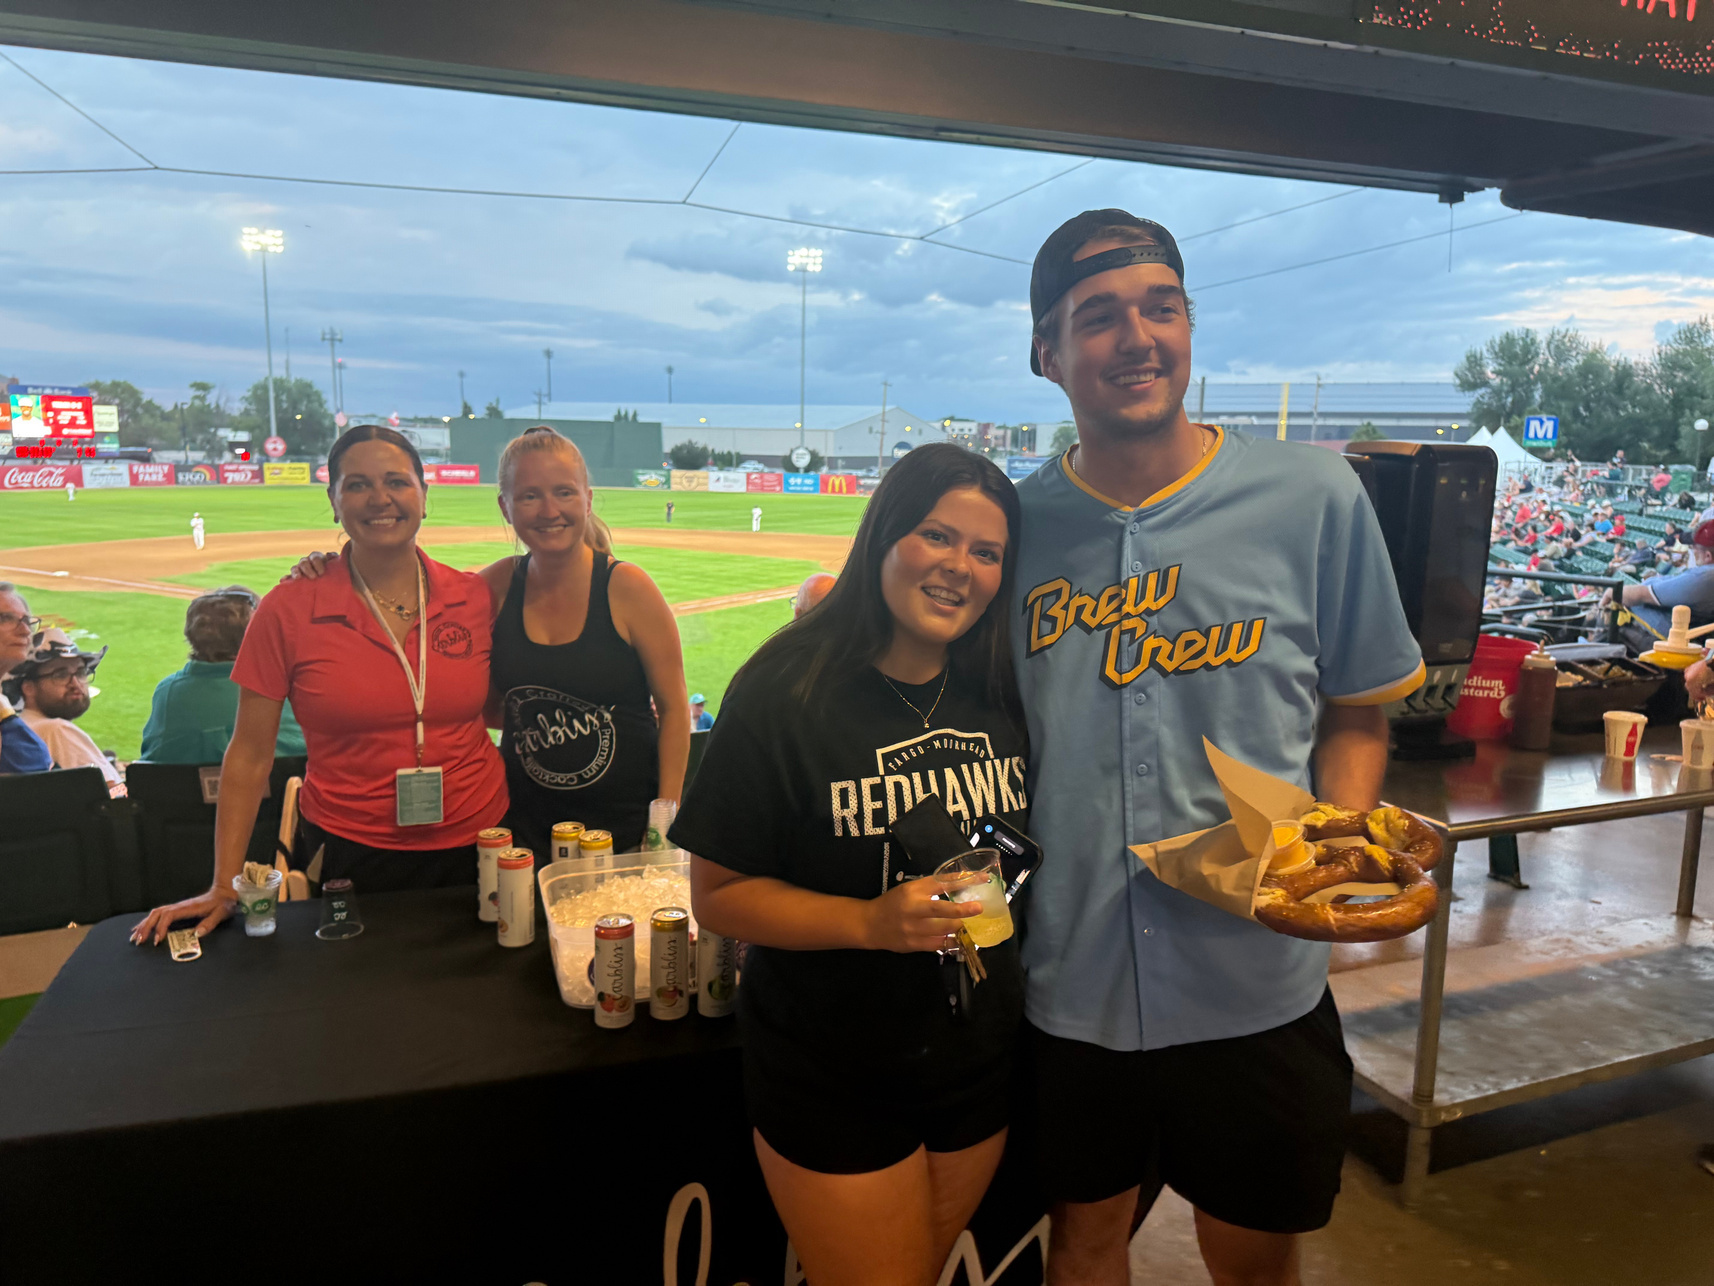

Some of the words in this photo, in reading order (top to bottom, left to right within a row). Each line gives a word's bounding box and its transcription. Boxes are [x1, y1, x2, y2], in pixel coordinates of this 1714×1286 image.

[1528, 419, 1554, 439] M
[132, 464, 169, 475] FAMILY
[1022, 563, 1182, 659] Brew
[1099, 615, 1267, 691] Crew
[1465, 675, 1505, 689] dium
[1460, 687, 1505, 699] stard
[830, 756, 1028, 837] REDHAWKS
